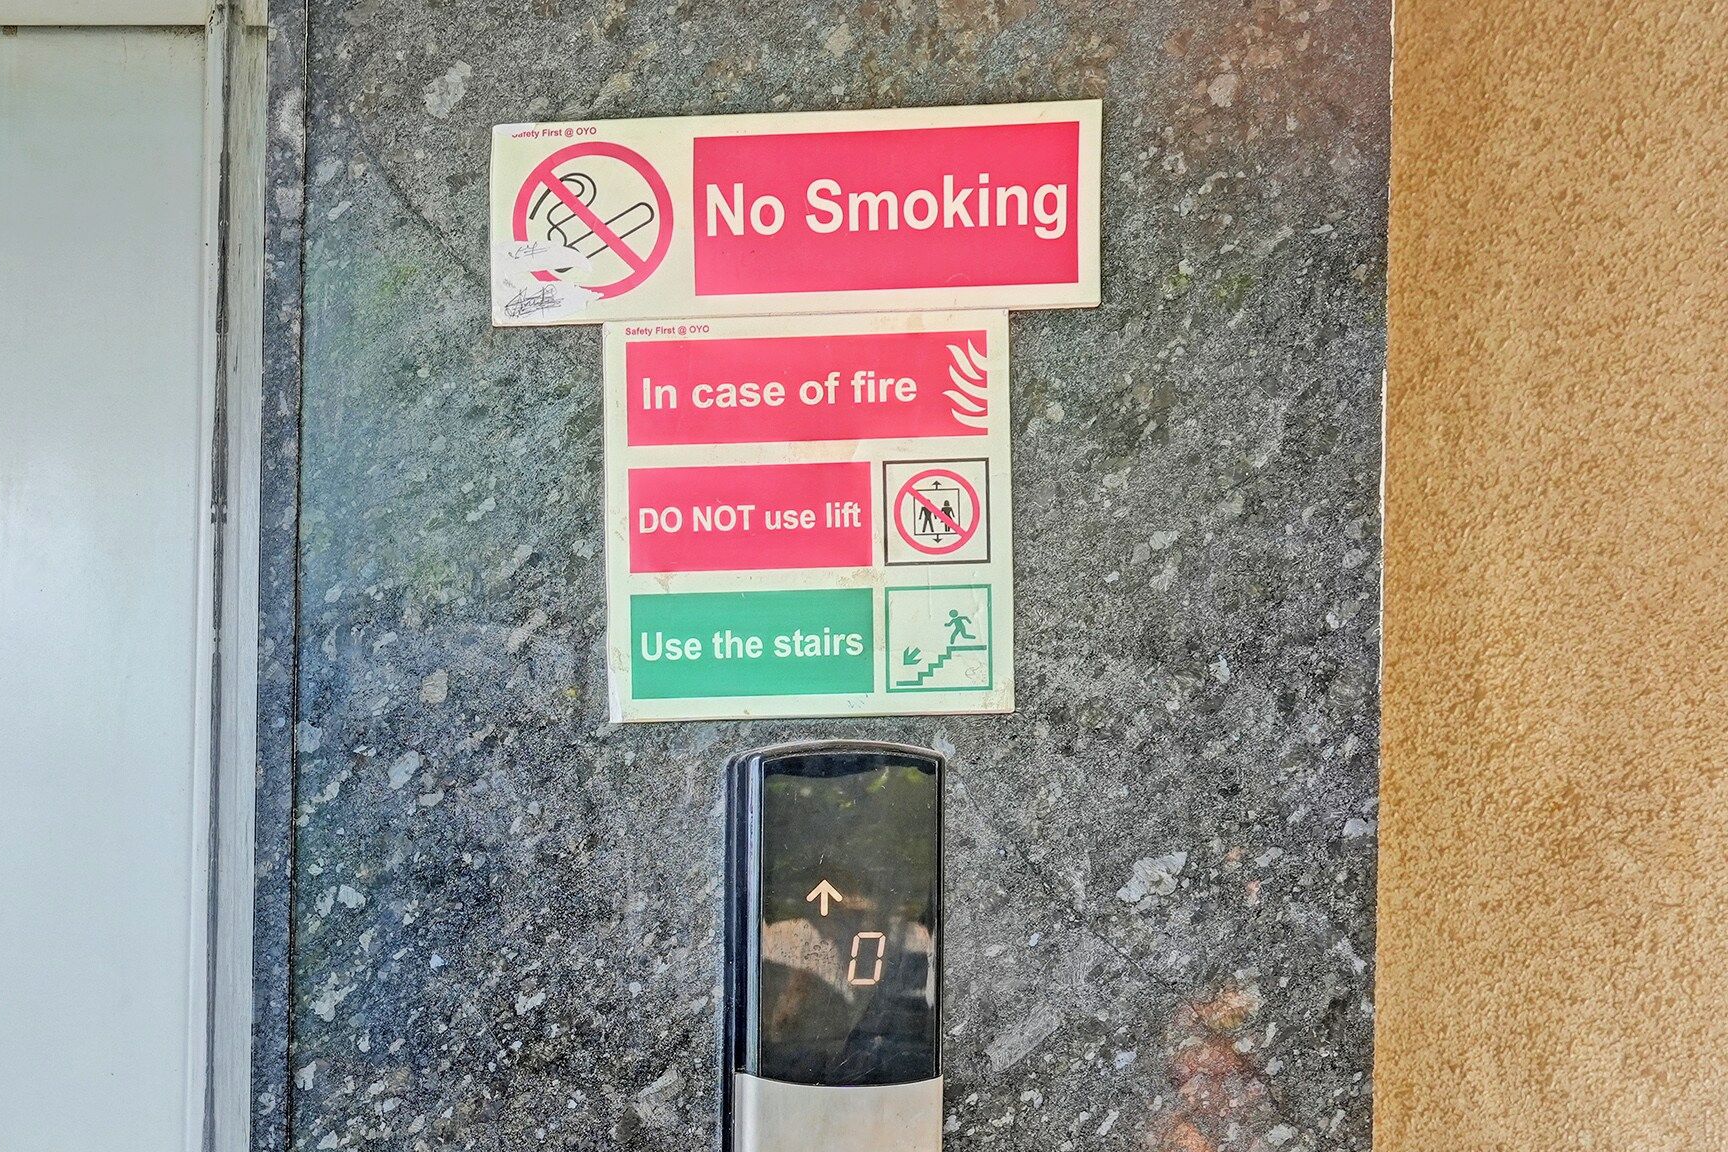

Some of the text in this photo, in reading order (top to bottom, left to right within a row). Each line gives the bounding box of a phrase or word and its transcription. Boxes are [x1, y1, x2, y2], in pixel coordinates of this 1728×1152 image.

[542, 128, 562, 137] First
[564, 128, 574, 138] @
[576, 126, 597, 136] OYO
[706, 173, 1068, 240] No Smoking
[625, 324, 710, 337] Safety First @ OYO
[642, 370, 918, 410] In case of fire
[638, 501, 862, 534] DO NOT use lift
[641, 627, 865, 662] Use the stairs
[847, 931, 886, 986] 0
